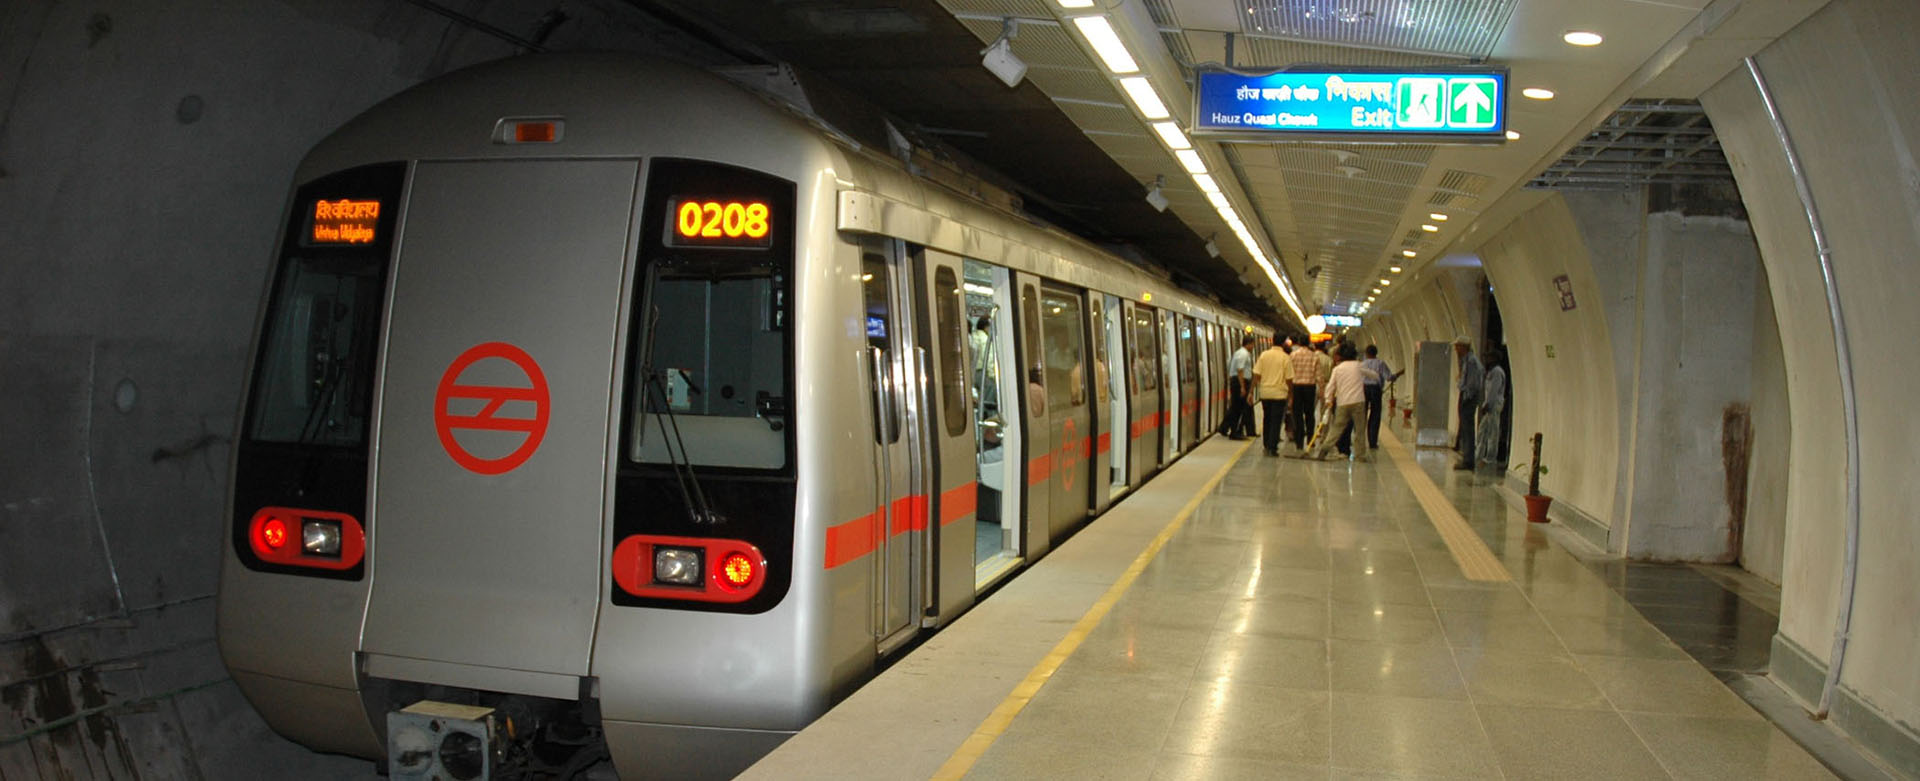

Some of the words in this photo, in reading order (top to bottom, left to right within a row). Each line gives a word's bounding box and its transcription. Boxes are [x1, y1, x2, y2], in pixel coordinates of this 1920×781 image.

[1325, 75, 1392, 102] निकास
[1212, 112, 1240, 124] Hauz
[1351, 106, 1392, 127] Exit
[679, 201, 769, 238] 0208
